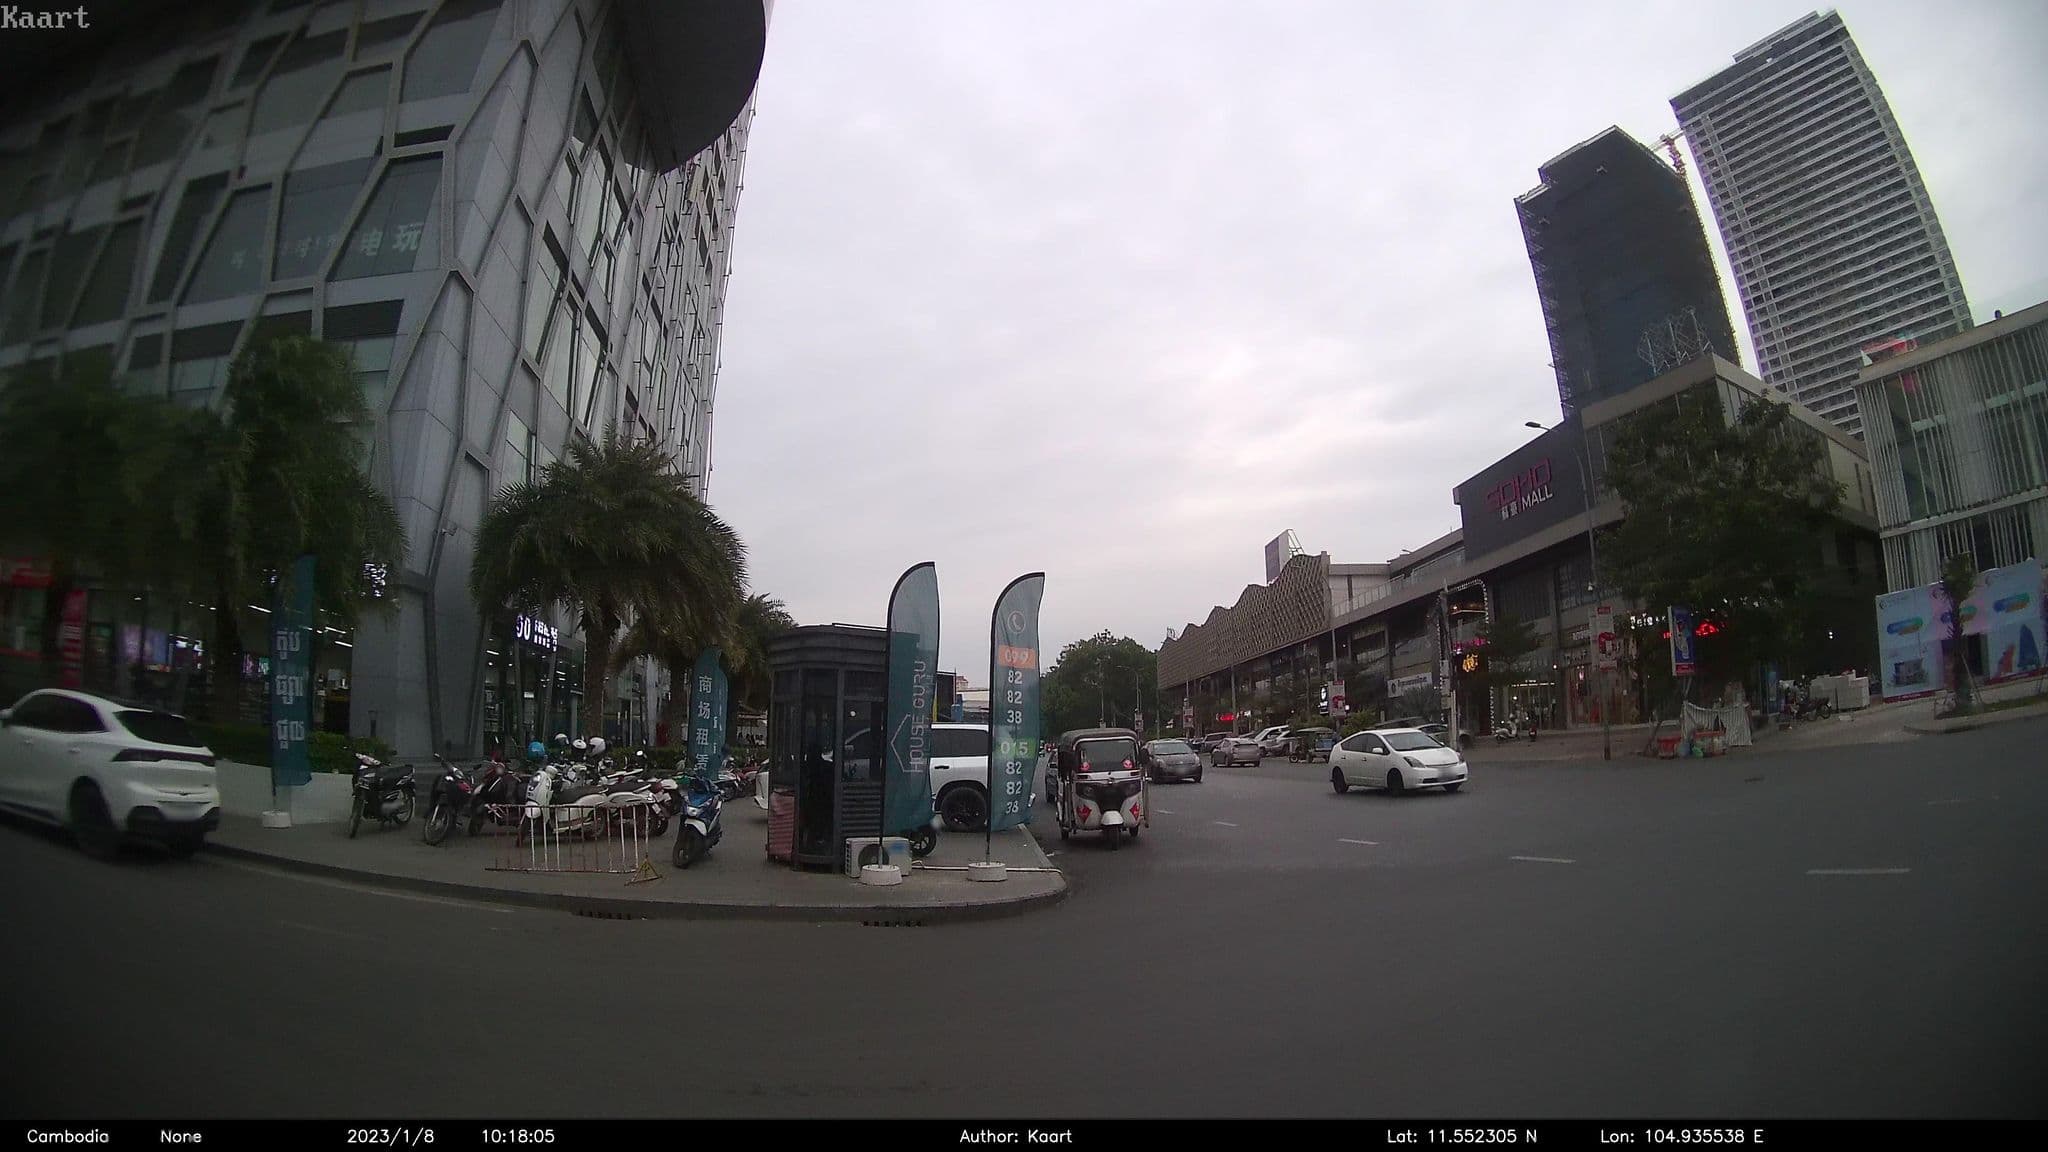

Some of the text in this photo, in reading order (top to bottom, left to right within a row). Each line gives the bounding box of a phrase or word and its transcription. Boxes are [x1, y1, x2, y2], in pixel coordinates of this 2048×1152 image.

[1522, 484, 1554, 512] MALL
[1008, 670, 1022, 685] 82
[1007, 690, 1023, 704] 82
[694, 675, 713, 771] 商场租赁
[909, 660, 927, 773] HOUSE GURU
[1006, 709, 1022, 724] 38
[1006, 761, 1022, 775] 82
[1006, 781, 1022, 795] 82
[1006, 800, 1019, 814] 38
